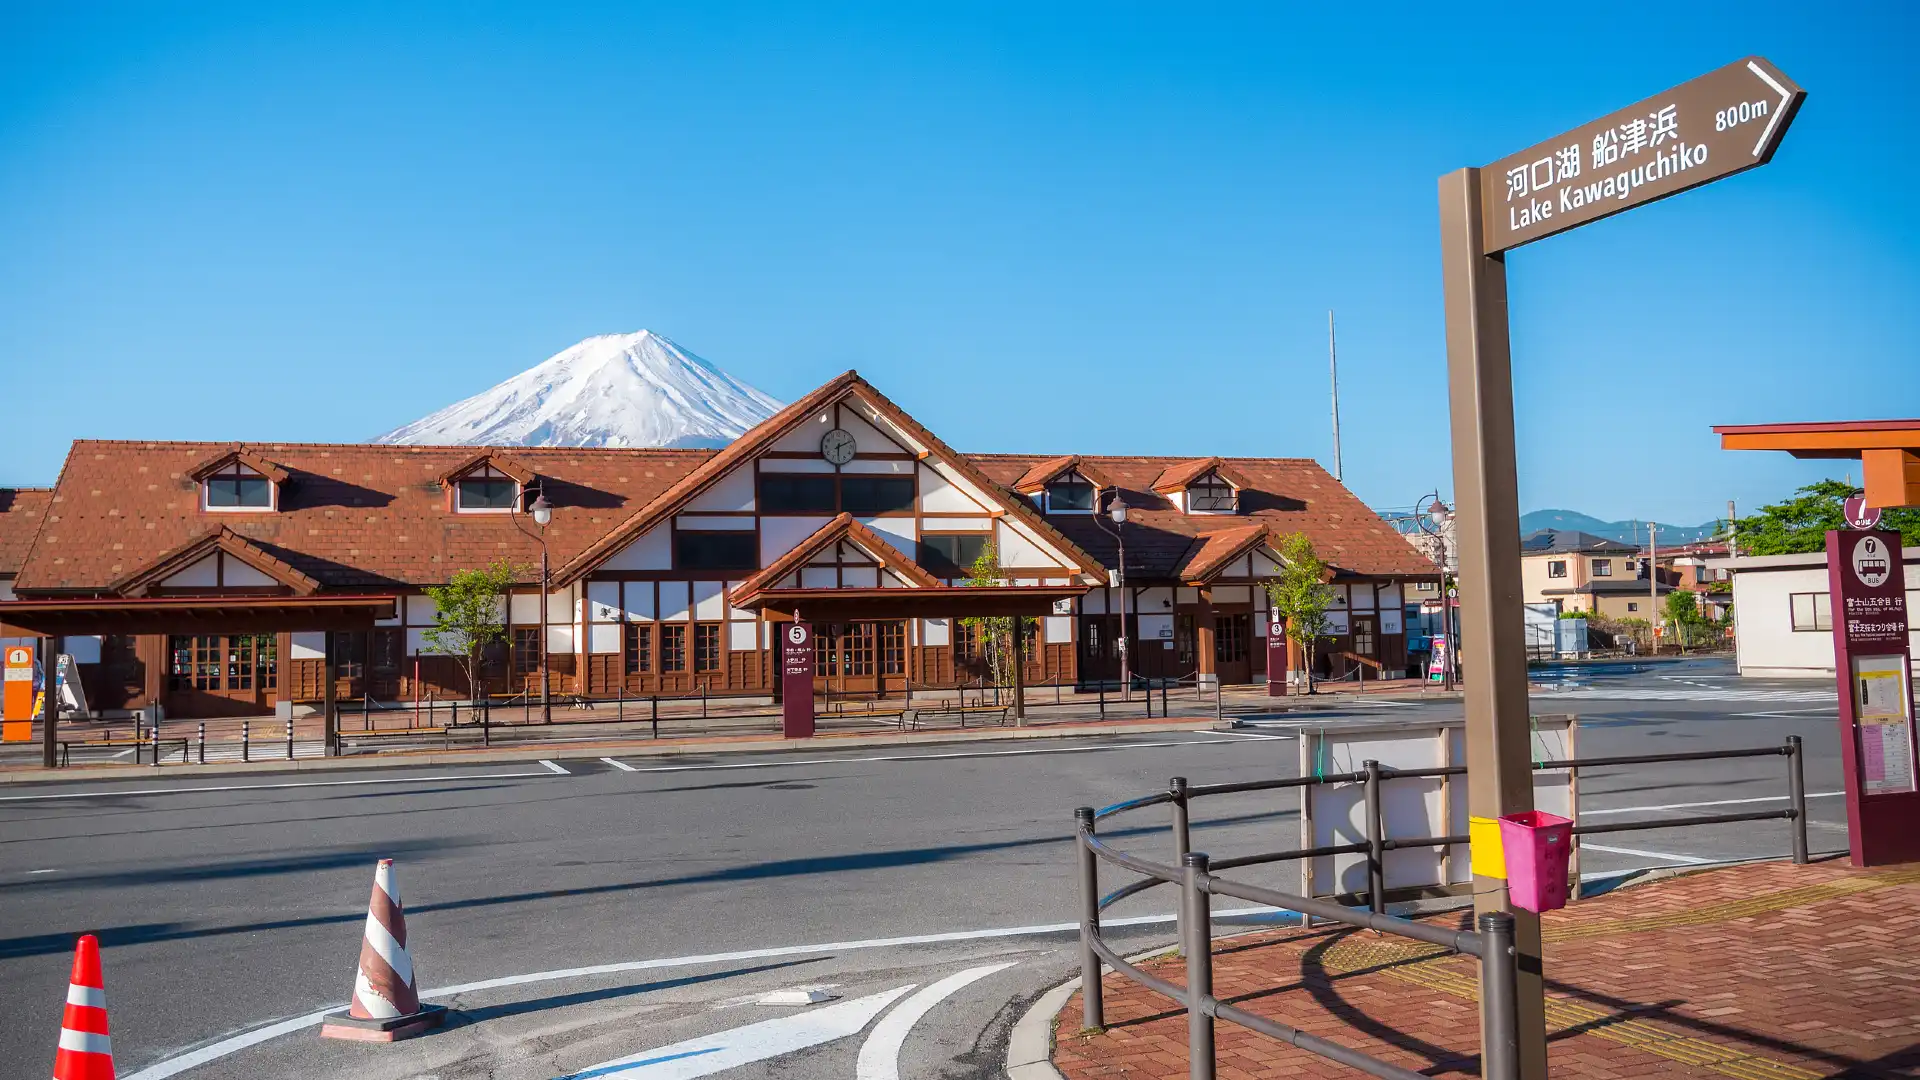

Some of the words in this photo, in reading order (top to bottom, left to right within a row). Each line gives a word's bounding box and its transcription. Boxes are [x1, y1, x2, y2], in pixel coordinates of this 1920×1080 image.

[1715, 98, 1768, 132] 800m
[1506, 144, 1580, 202] 河口湖
[1592, 104, 1678, 170] 船津浜
[1510, 198, 1552, 231] Lake
[1560, 142, 1708, 213] Kawaguchiko
[1866, 540, 1874, 552] 7
[1846, 597, 1891, 607] 富士山五合目
[1894, 597, 1902, 606] 行
[1898, 622, 1905, 631] 行
[793, 628, 802, 639] 5
[16, 652, 20, 661] 1
